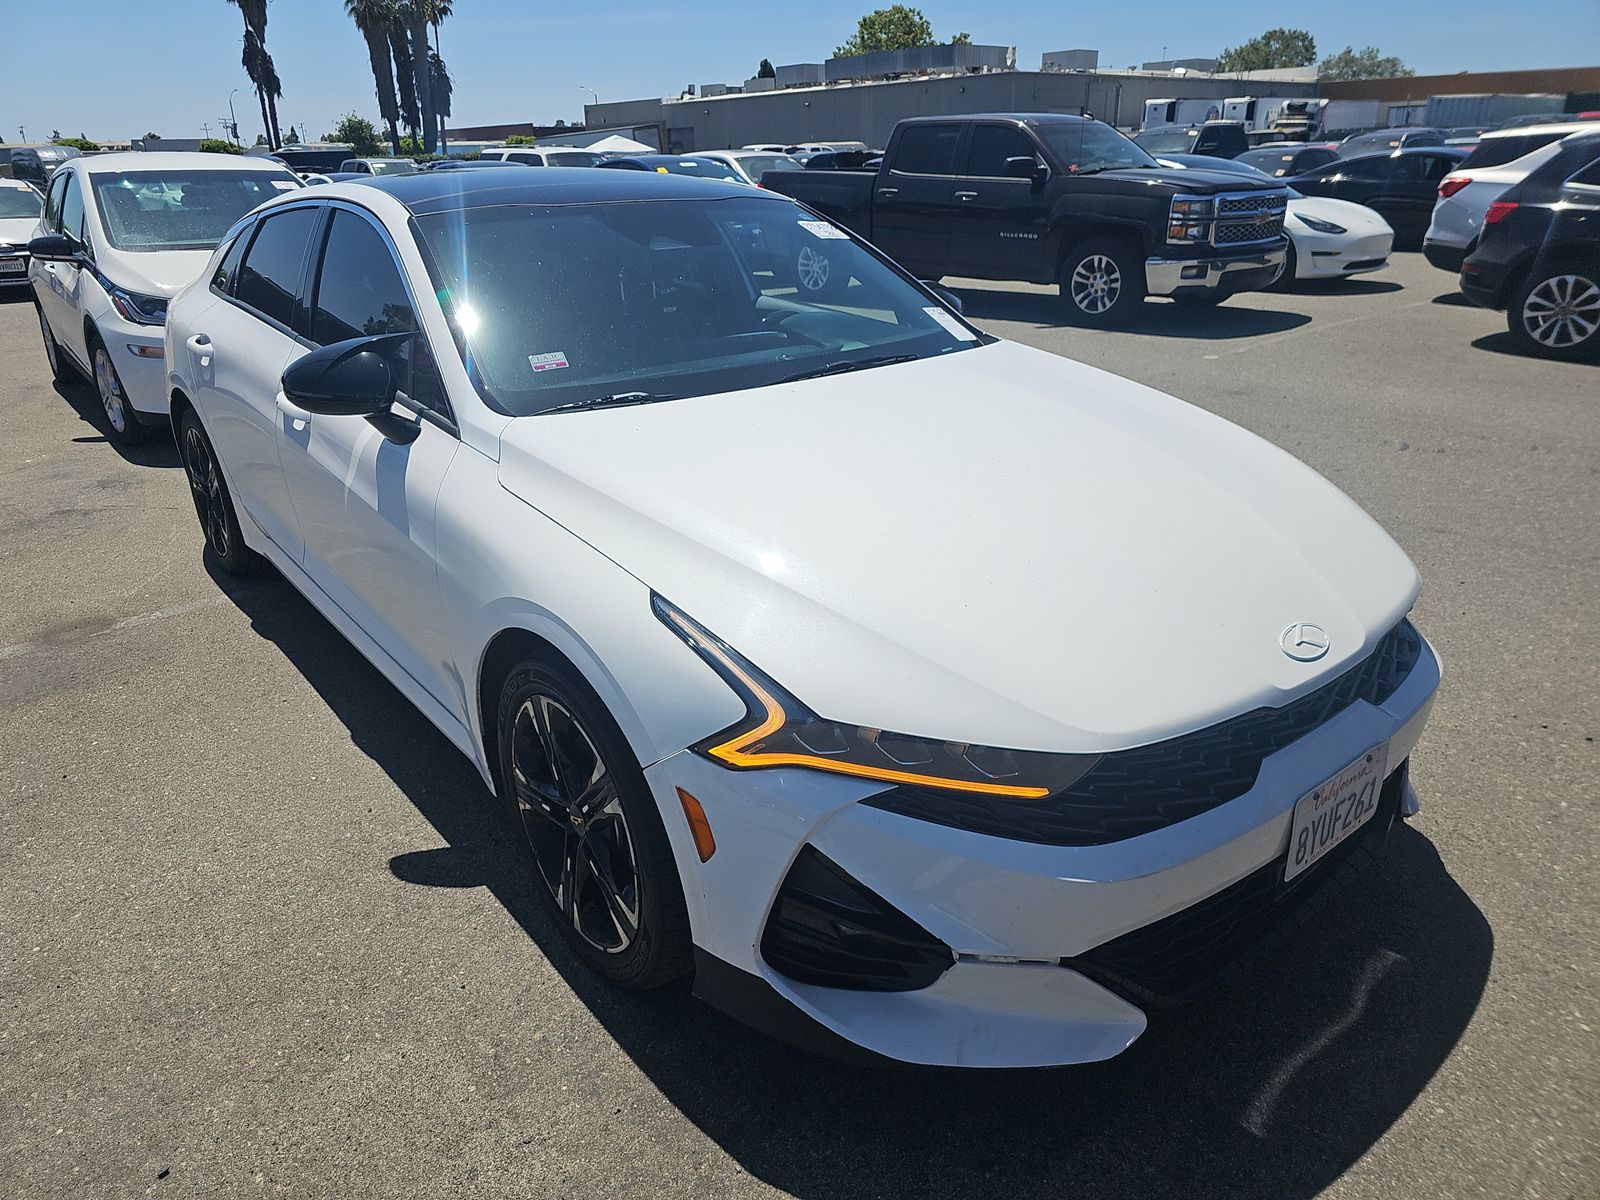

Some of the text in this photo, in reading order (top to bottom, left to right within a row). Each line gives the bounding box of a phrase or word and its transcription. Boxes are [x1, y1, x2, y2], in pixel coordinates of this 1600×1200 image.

[999, 231, 1038, 240] SILVERADO
[1314, 763, 1373, 811] California
[1295, 776, 1377, 866] 8YUF261
